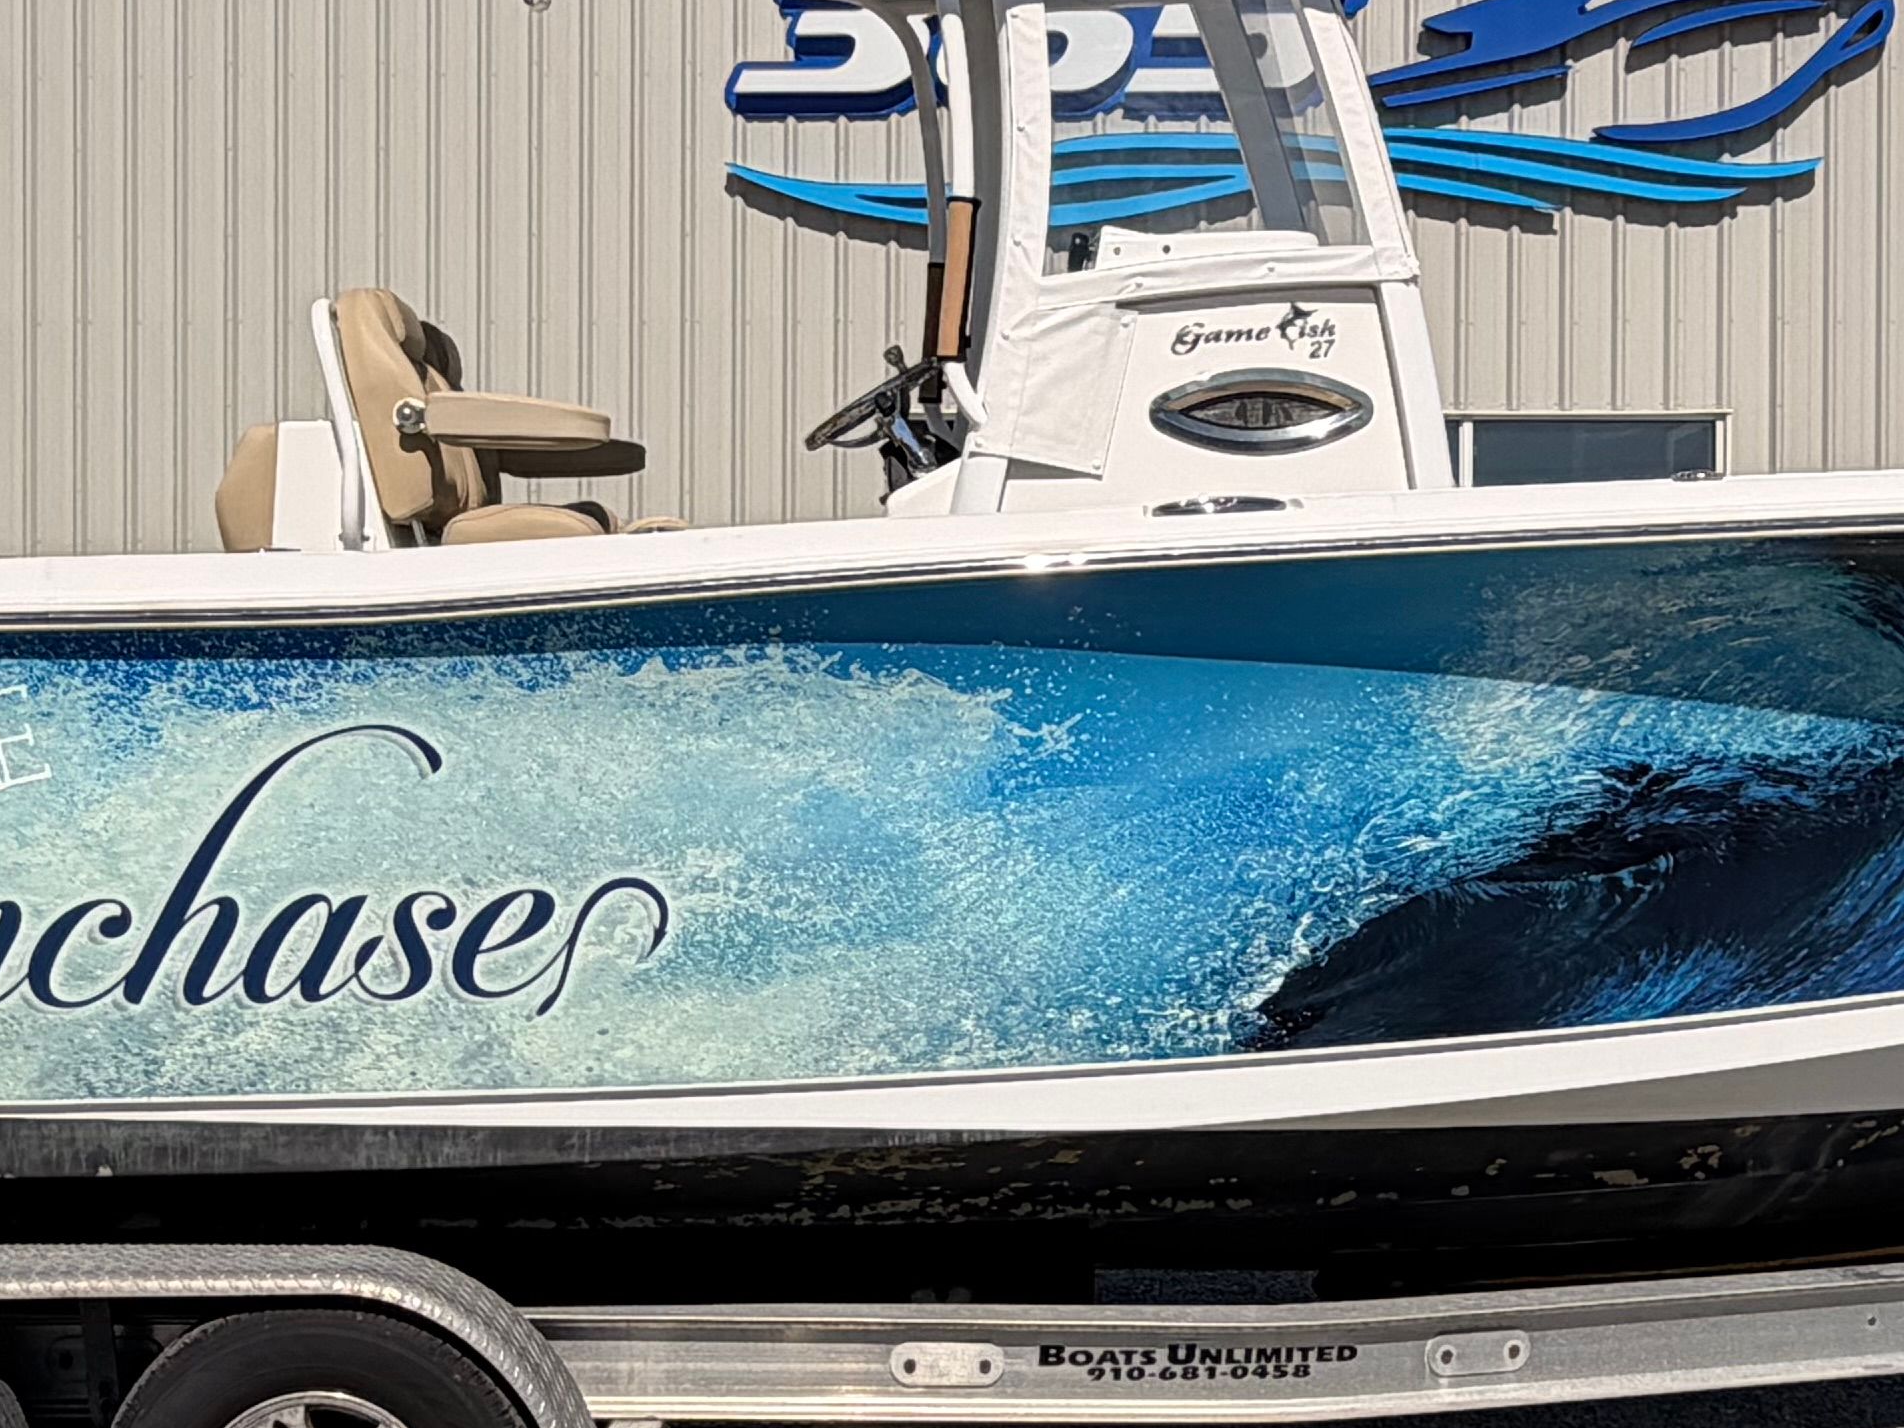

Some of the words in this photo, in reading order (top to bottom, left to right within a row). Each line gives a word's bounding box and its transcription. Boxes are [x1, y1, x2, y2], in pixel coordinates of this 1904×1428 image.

[1308, 339, 1336, 359] 27
[1038, 1344, 1157, 1367] BOATS
[1167, 1343, 1358, 1366] UNLIMITED
[1086, 1363, 1312, 1382] 910-681-0458
